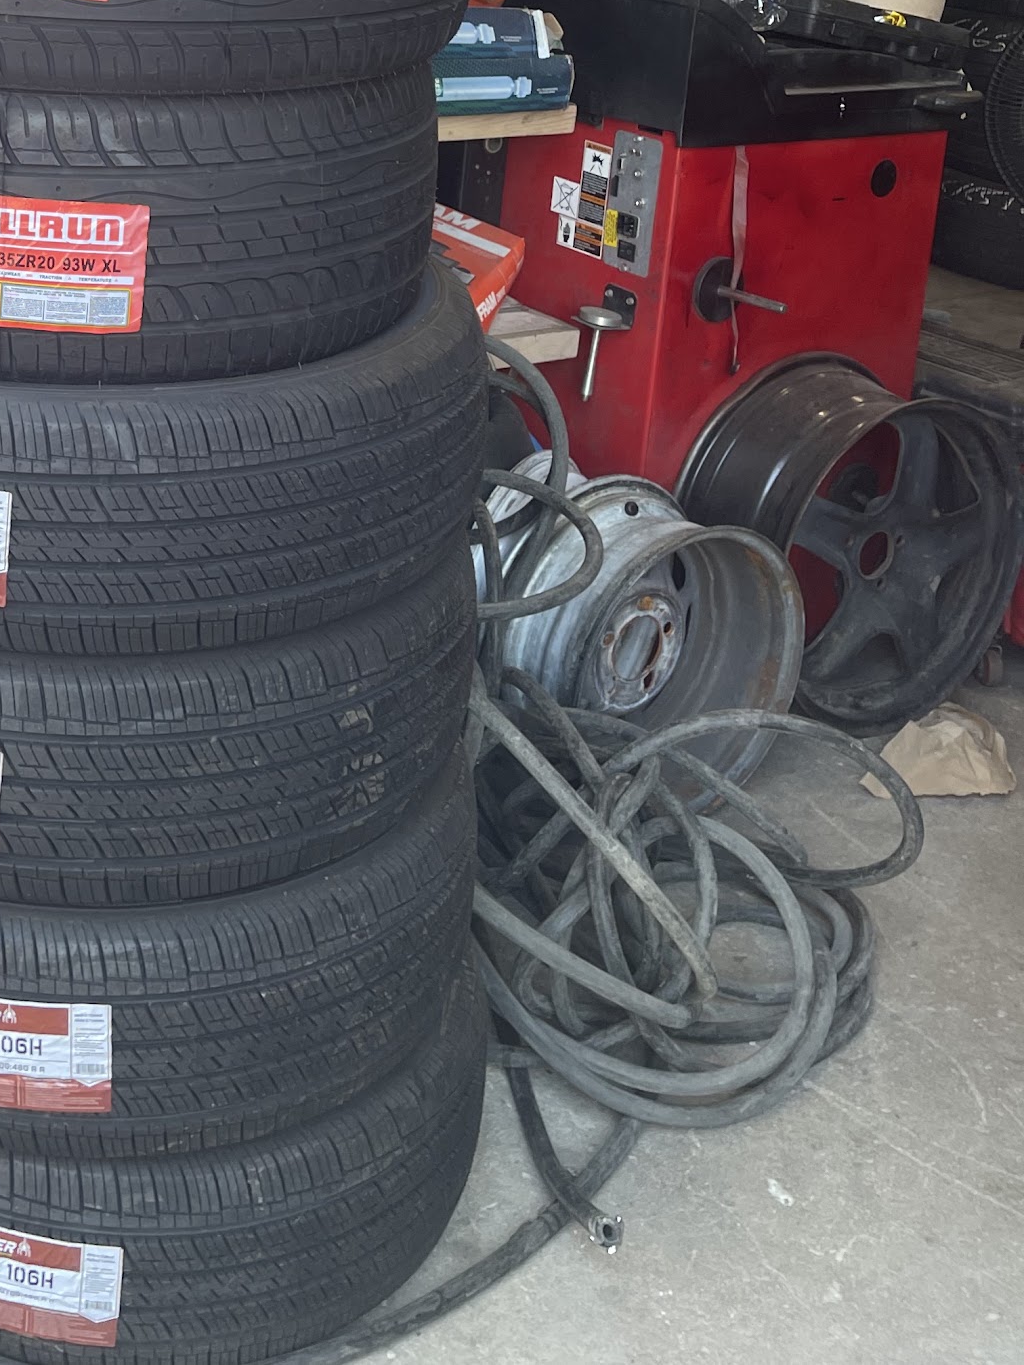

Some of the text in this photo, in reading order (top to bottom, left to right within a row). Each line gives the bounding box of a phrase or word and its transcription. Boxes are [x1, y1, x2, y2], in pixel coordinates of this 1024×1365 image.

[62, 255, 95, 272] 93W
[102, 258, 121, 273] XL
[476, 291, 497, 323] FRAM
[7, 1263, 54, 1289] 106H
